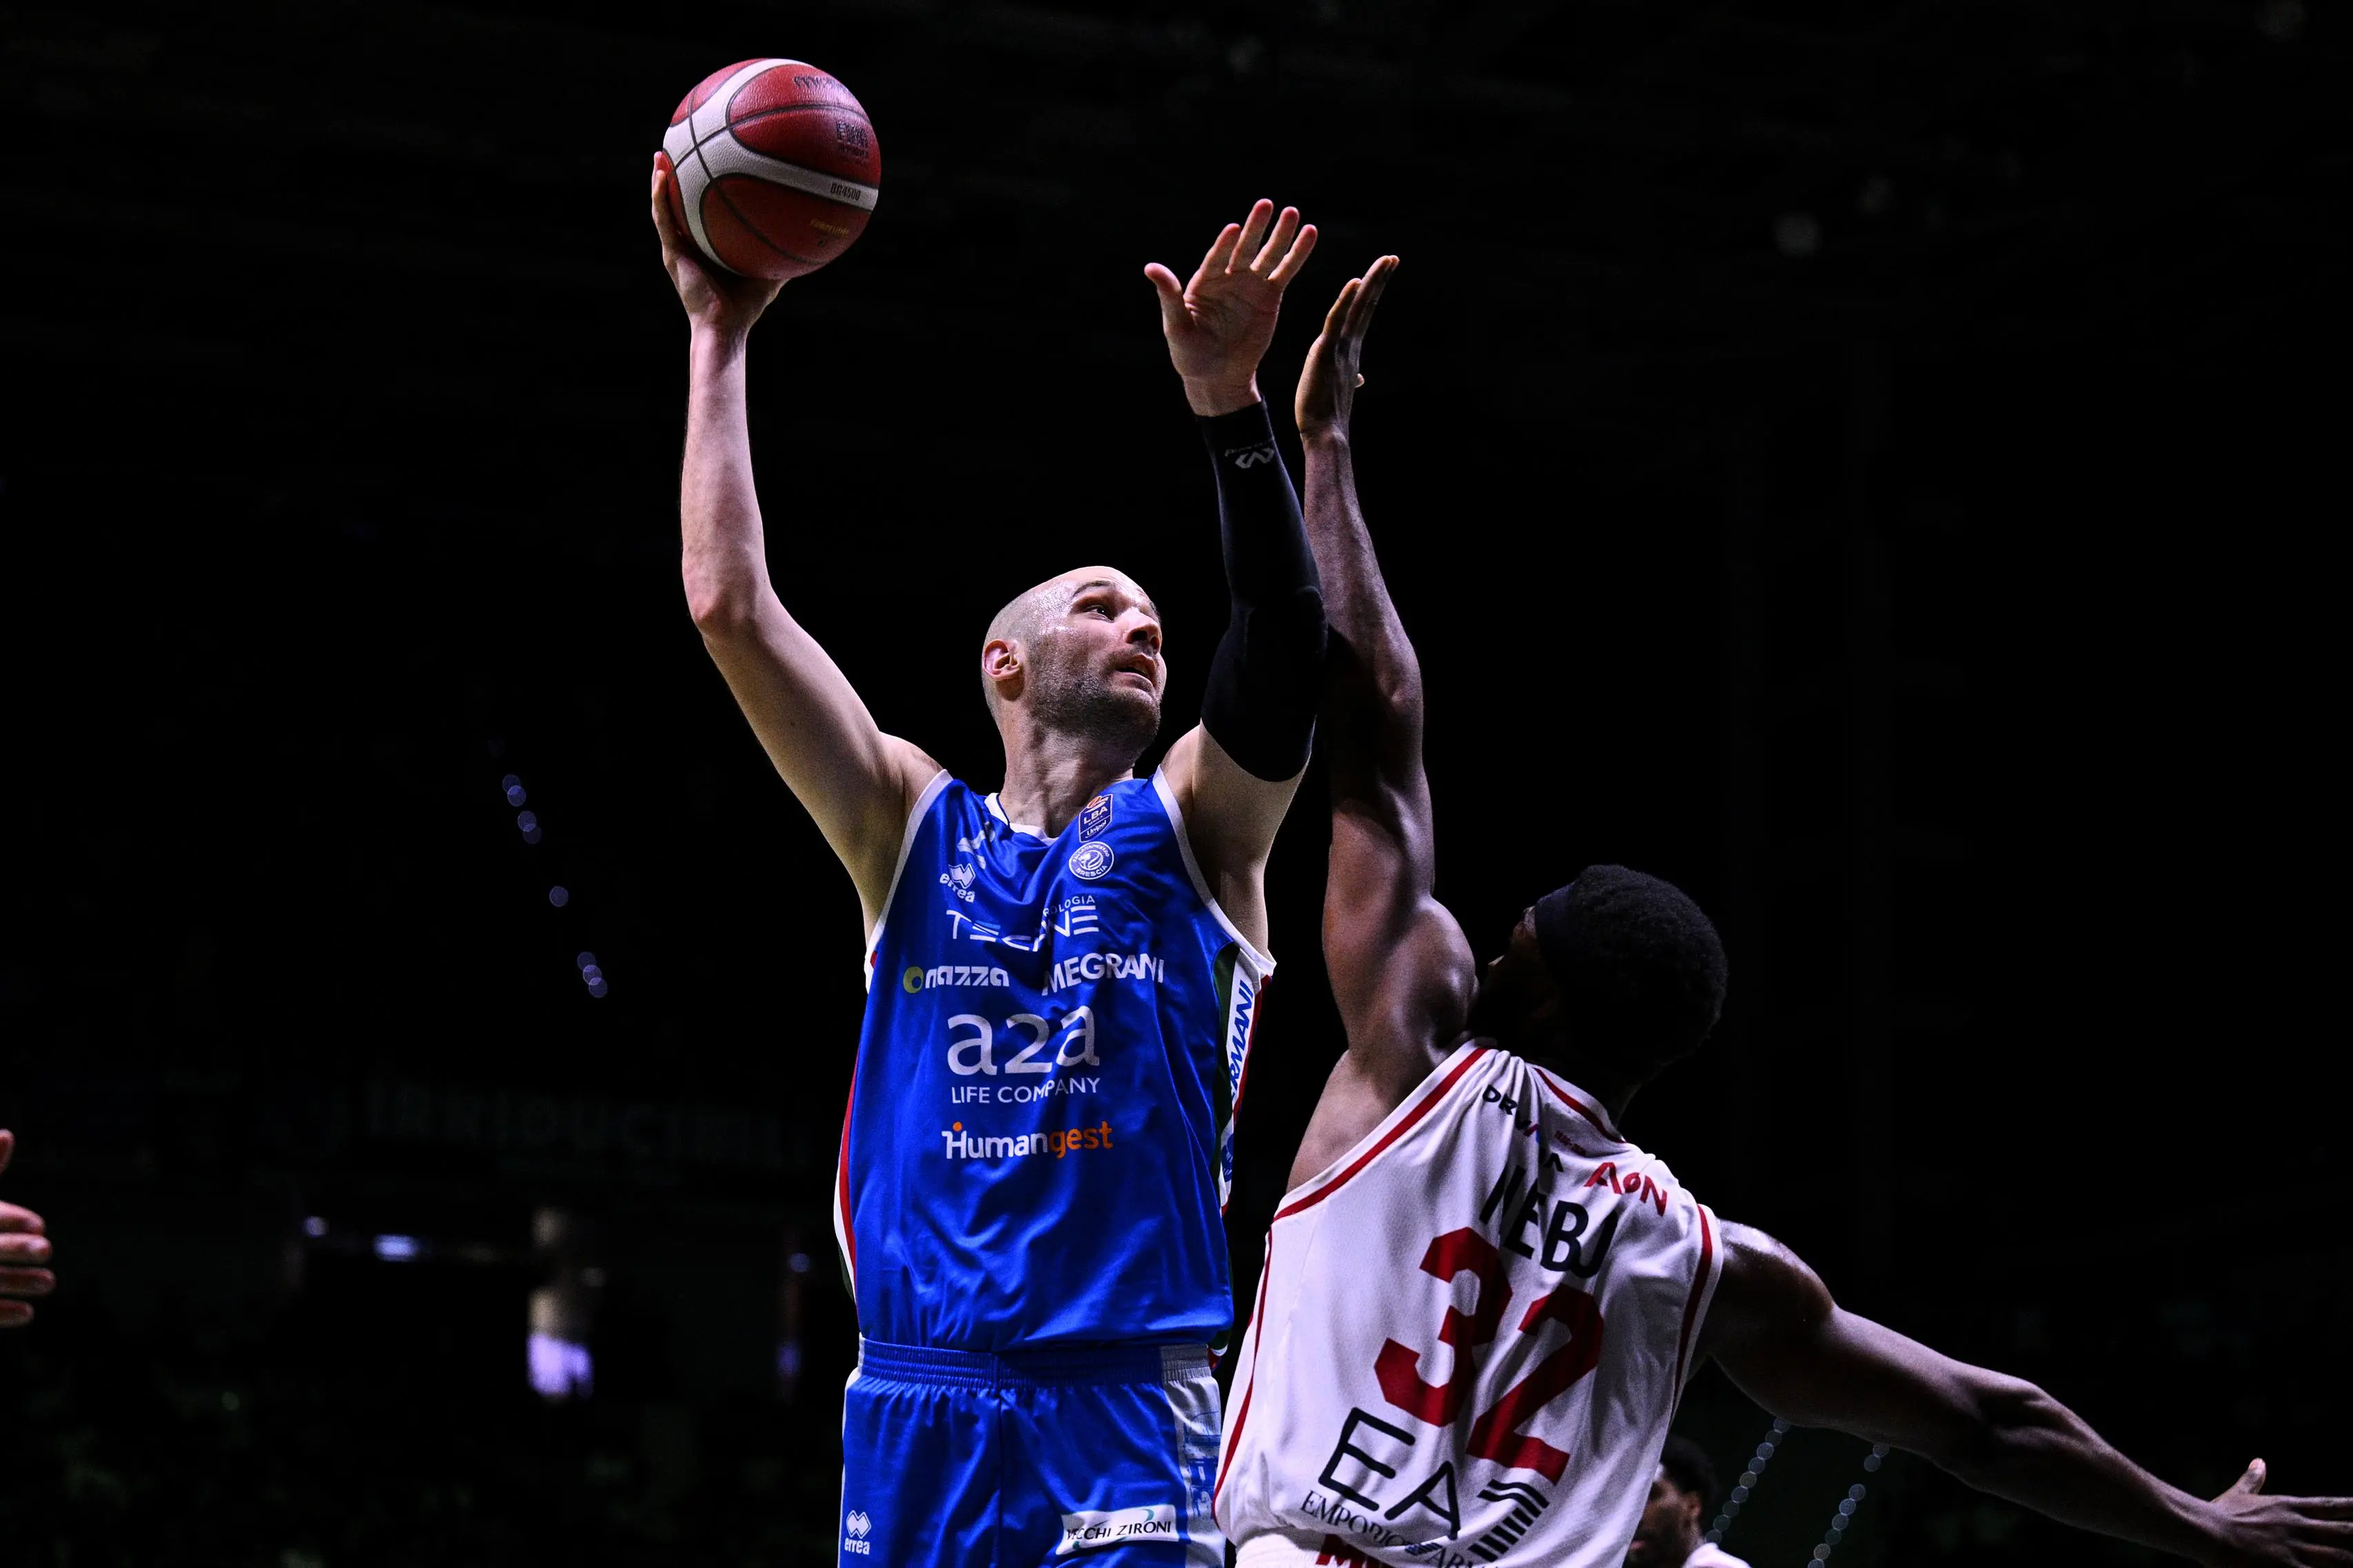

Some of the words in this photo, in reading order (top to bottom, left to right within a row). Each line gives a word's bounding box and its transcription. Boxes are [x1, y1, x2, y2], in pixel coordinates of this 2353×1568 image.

[1083, 806, 1108, 824] LBA
[1087, 819, 1106, 836] Unipol
[1075, 865, 1108, 877] BRESCIA
[947, 1005, 1101, 1075] a2a
[951, 1086, 990, 1104] LIFE
[997, 1077, 1101, 1103] COMPANY
[941, 1121, 1114, 1159] Humangest
[1374, 1227, 1604, 1485] 32
[1117, 1521, 1171, 1536] ZIRONI
